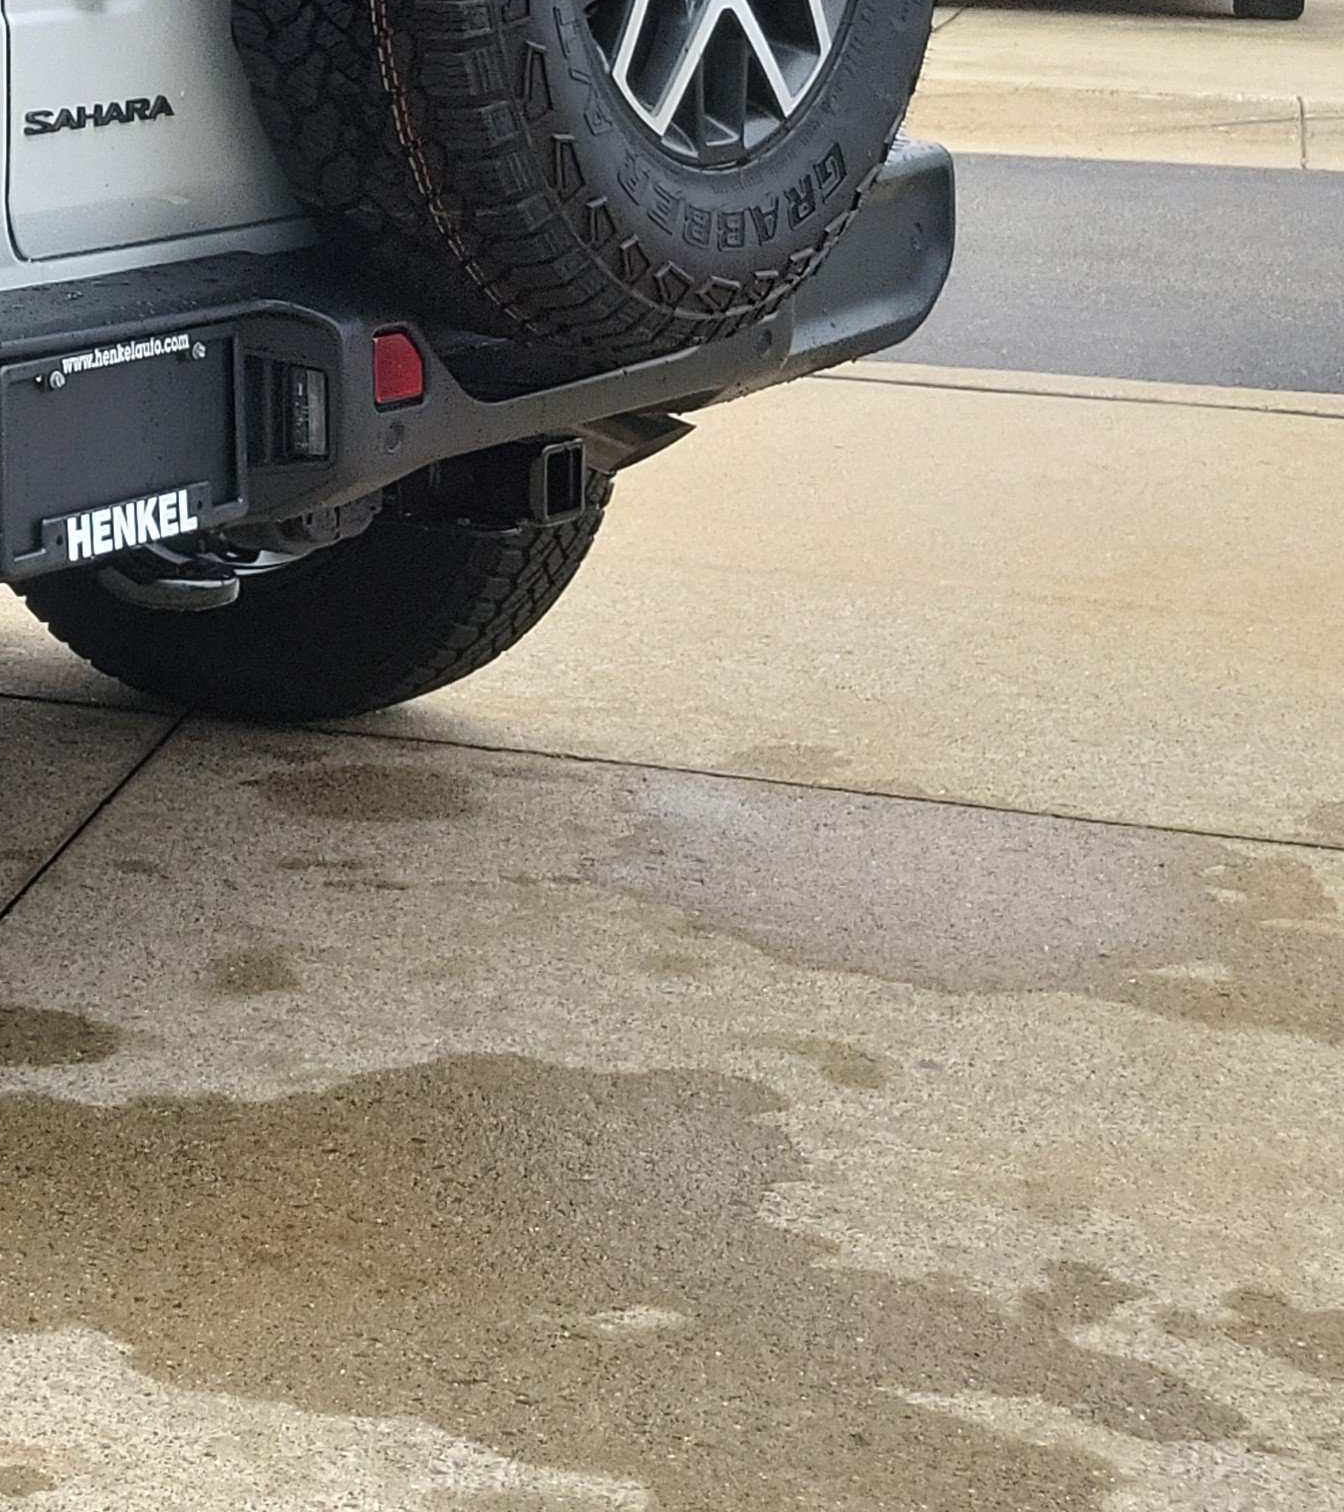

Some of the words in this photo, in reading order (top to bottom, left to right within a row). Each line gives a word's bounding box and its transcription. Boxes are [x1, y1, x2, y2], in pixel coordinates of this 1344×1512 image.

[23, 94, 175, 137] SAHARA
[616, 141, 848, 252] GRABBER
[62, 333, 190, 375] www.henkelauto.com
[66, 489, 199, 562] HENKEL
